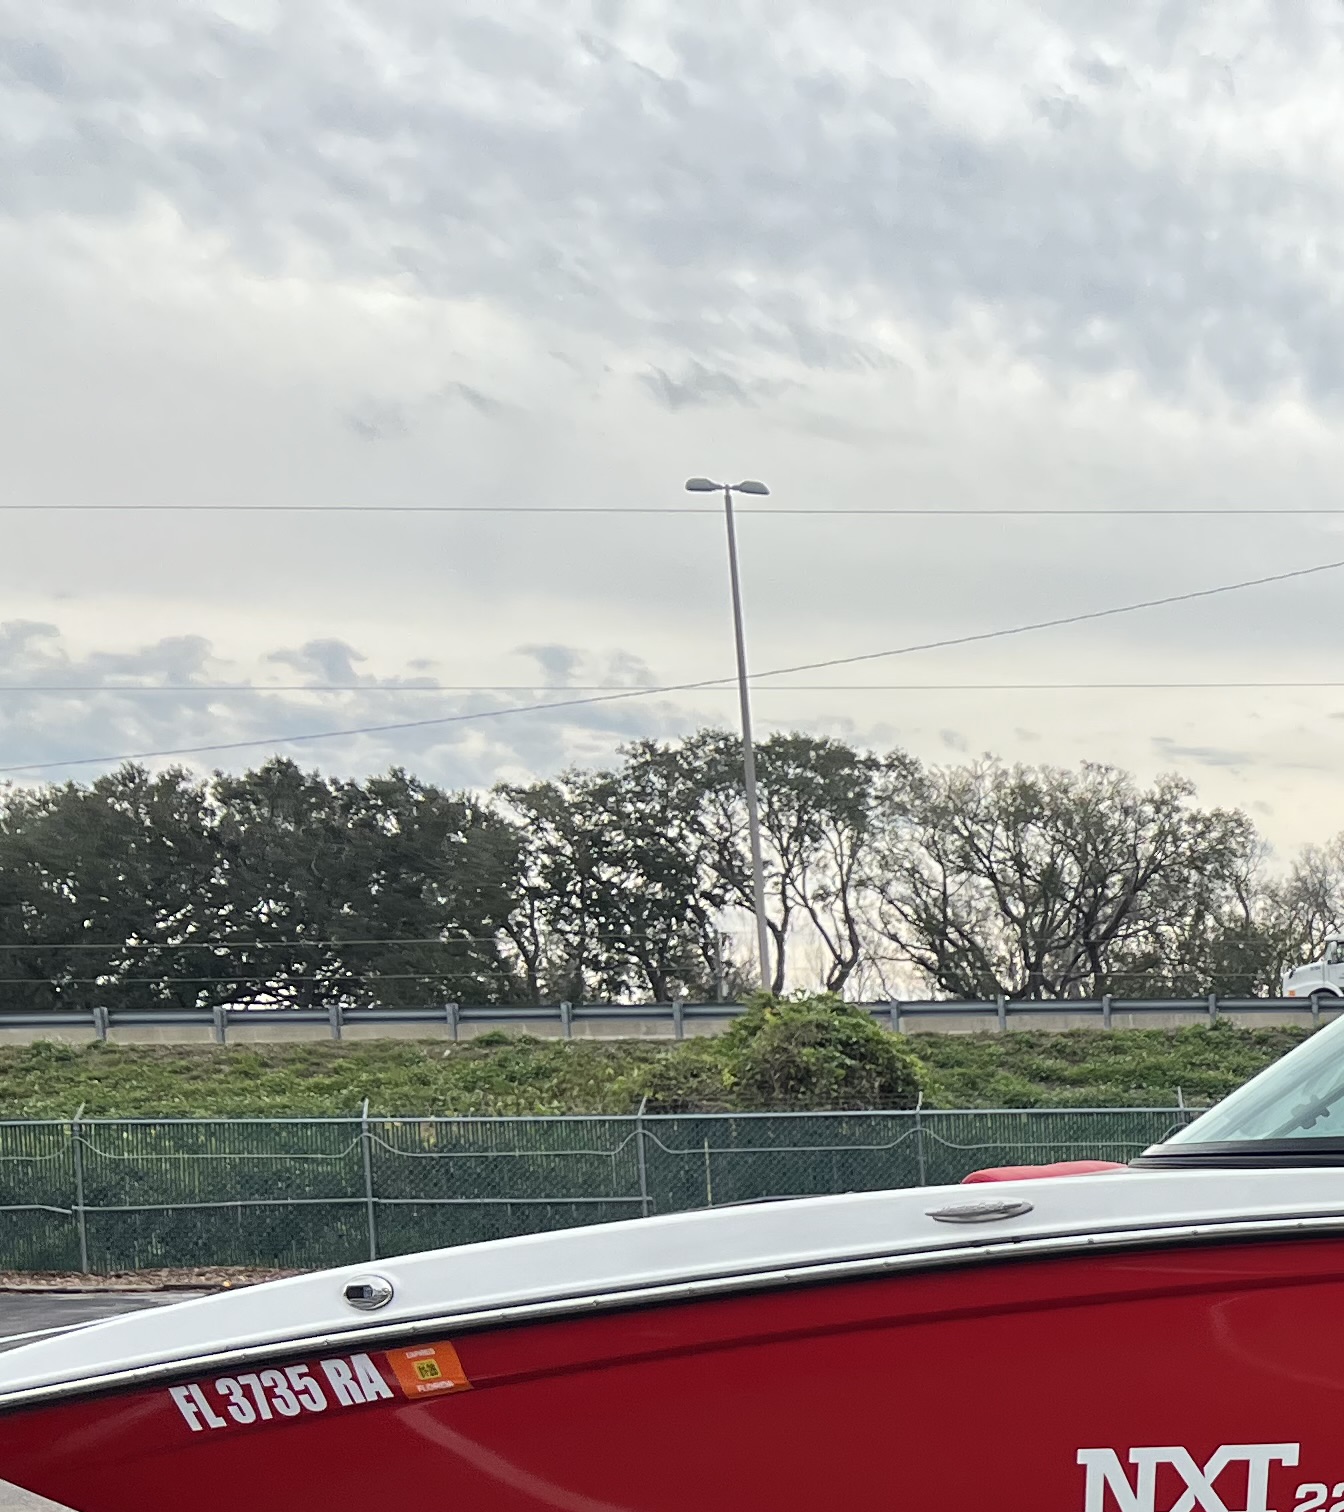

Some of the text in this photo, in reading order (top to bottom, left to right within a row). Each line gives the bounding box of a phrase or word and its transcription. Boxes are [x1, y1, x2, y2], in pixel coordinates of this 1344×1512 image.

[168, 1352, 394, 1432] FL 3735 RA
